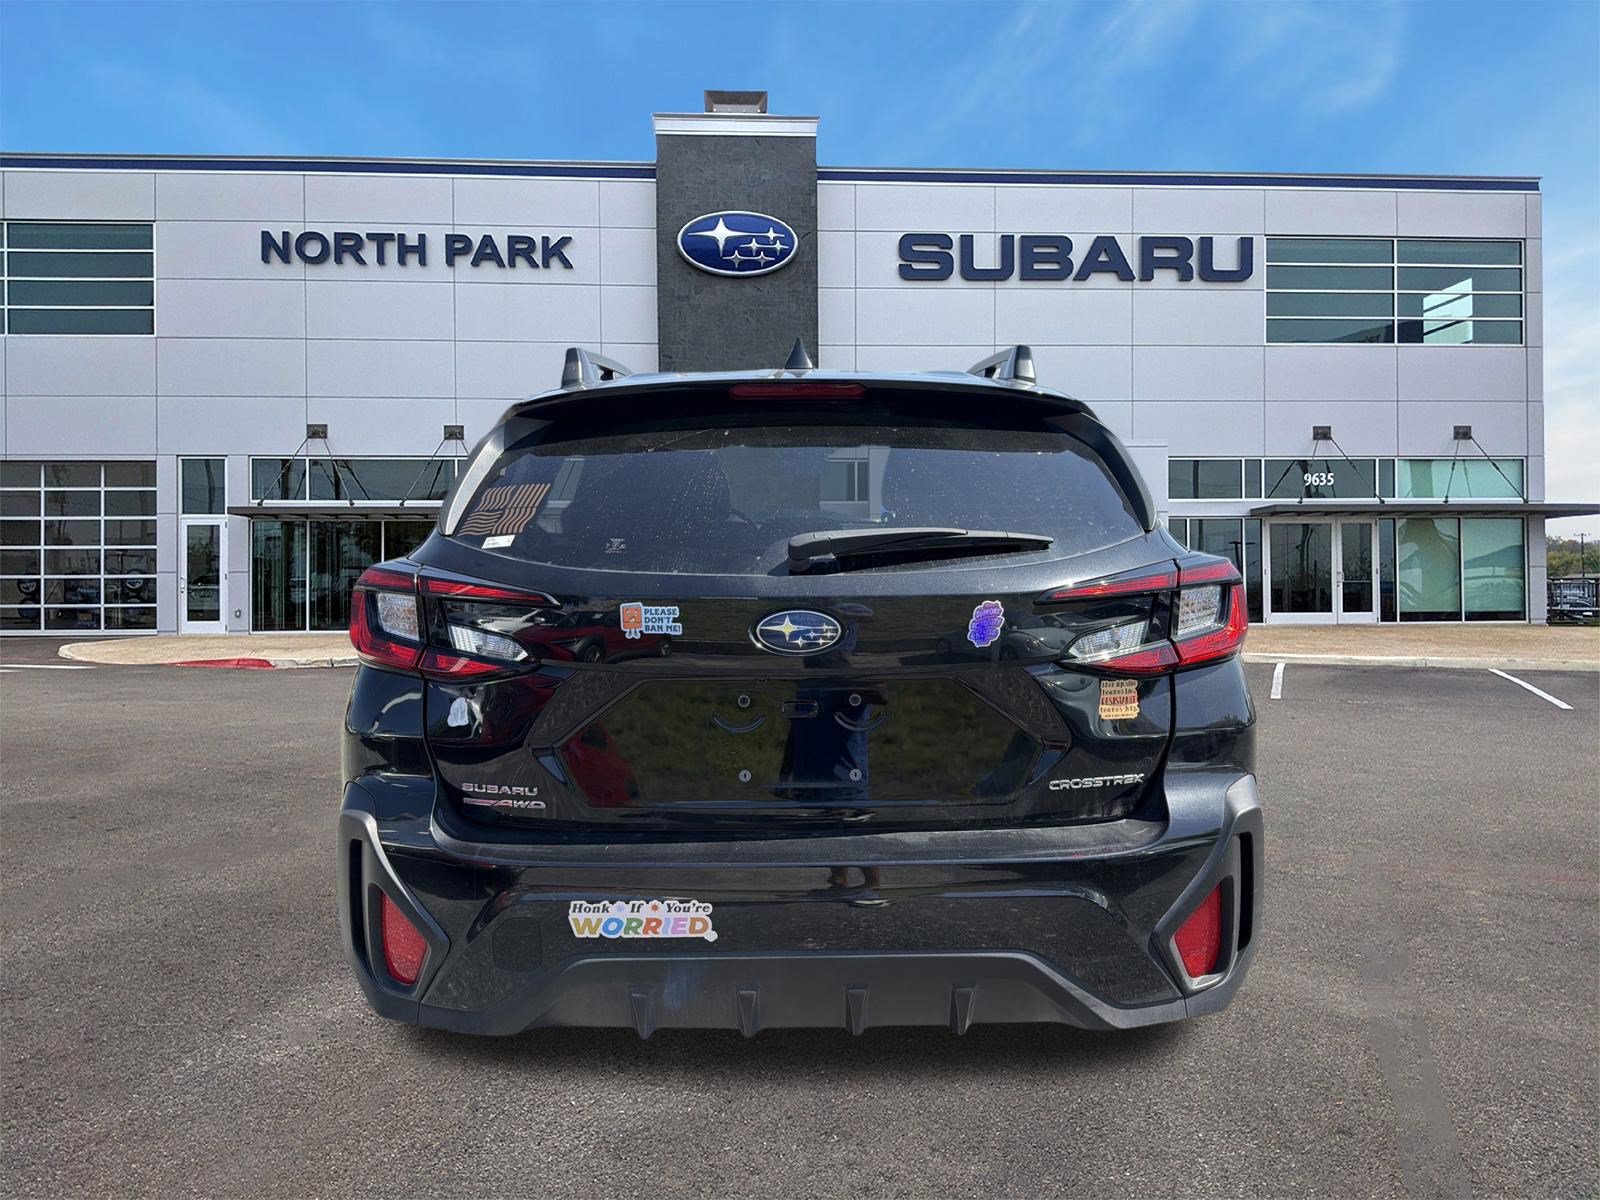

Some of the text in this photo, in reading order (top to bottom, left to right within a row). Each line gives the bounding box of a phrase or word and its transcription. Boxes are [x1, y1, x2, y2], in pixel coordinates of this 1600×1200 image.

[260, 230, 574, 269] NORTH PARK
[898, 232, 1254, 282] SUBARU
[1303, 472, 1335, 487] 9635
[644, 608, 678, 616] PLEASE
[644, 616, 672, 624] DON'T
[644, 624, 681, 632] BAN ME!
[461, 782, 538, 796] SUBARU
[1048, 773, 1145, 791] CROSSTREK
[494, 799, 546, 809] AWD
[571, 902, 711, 914] Honk If You're
[571, 916, 710, 936] WORRIED
